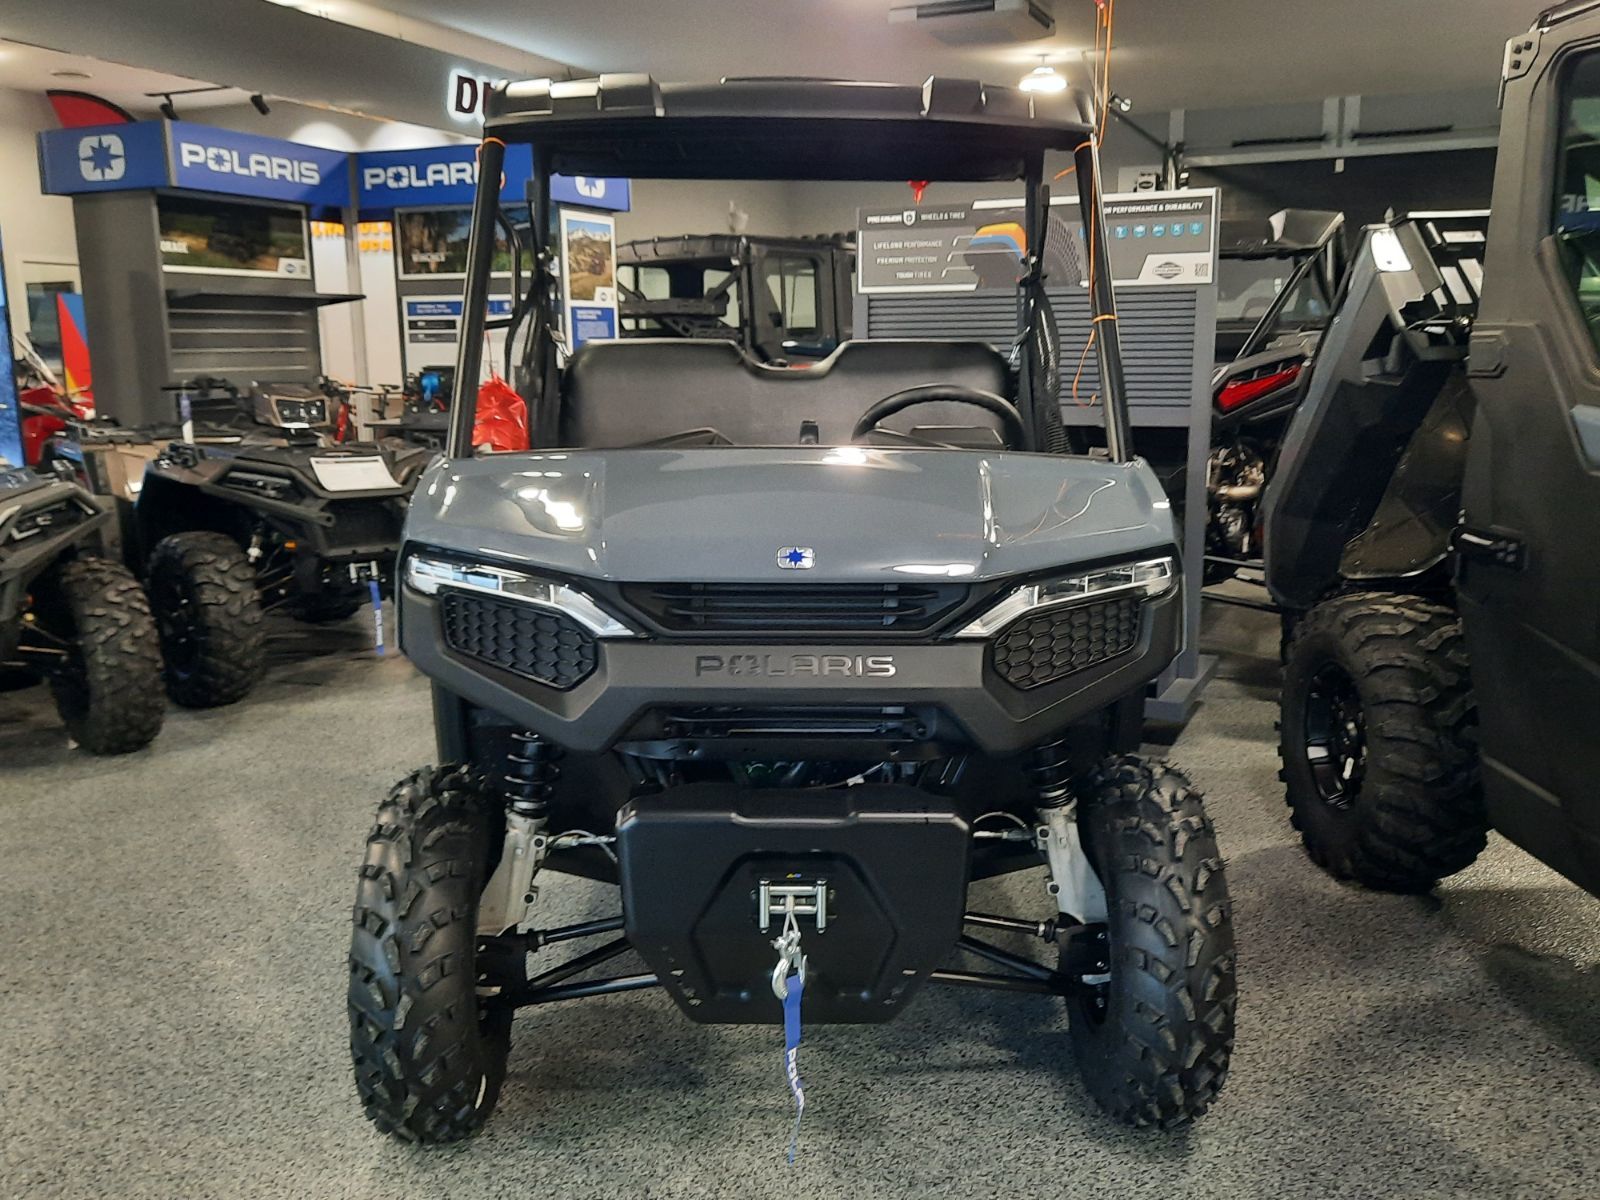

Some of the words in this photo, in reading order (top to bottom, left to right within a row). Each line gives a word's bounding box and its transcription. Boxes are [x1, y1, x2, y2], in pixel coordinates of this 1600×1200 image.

[455, 75, 492, 114] D
[180, 142, 320, 186] POLARIS
[364, 162, 480, 190] POLARI
[1165, 201, 1204, 211] DURABILITY
[695, 655, 897, 677] POLARIS
